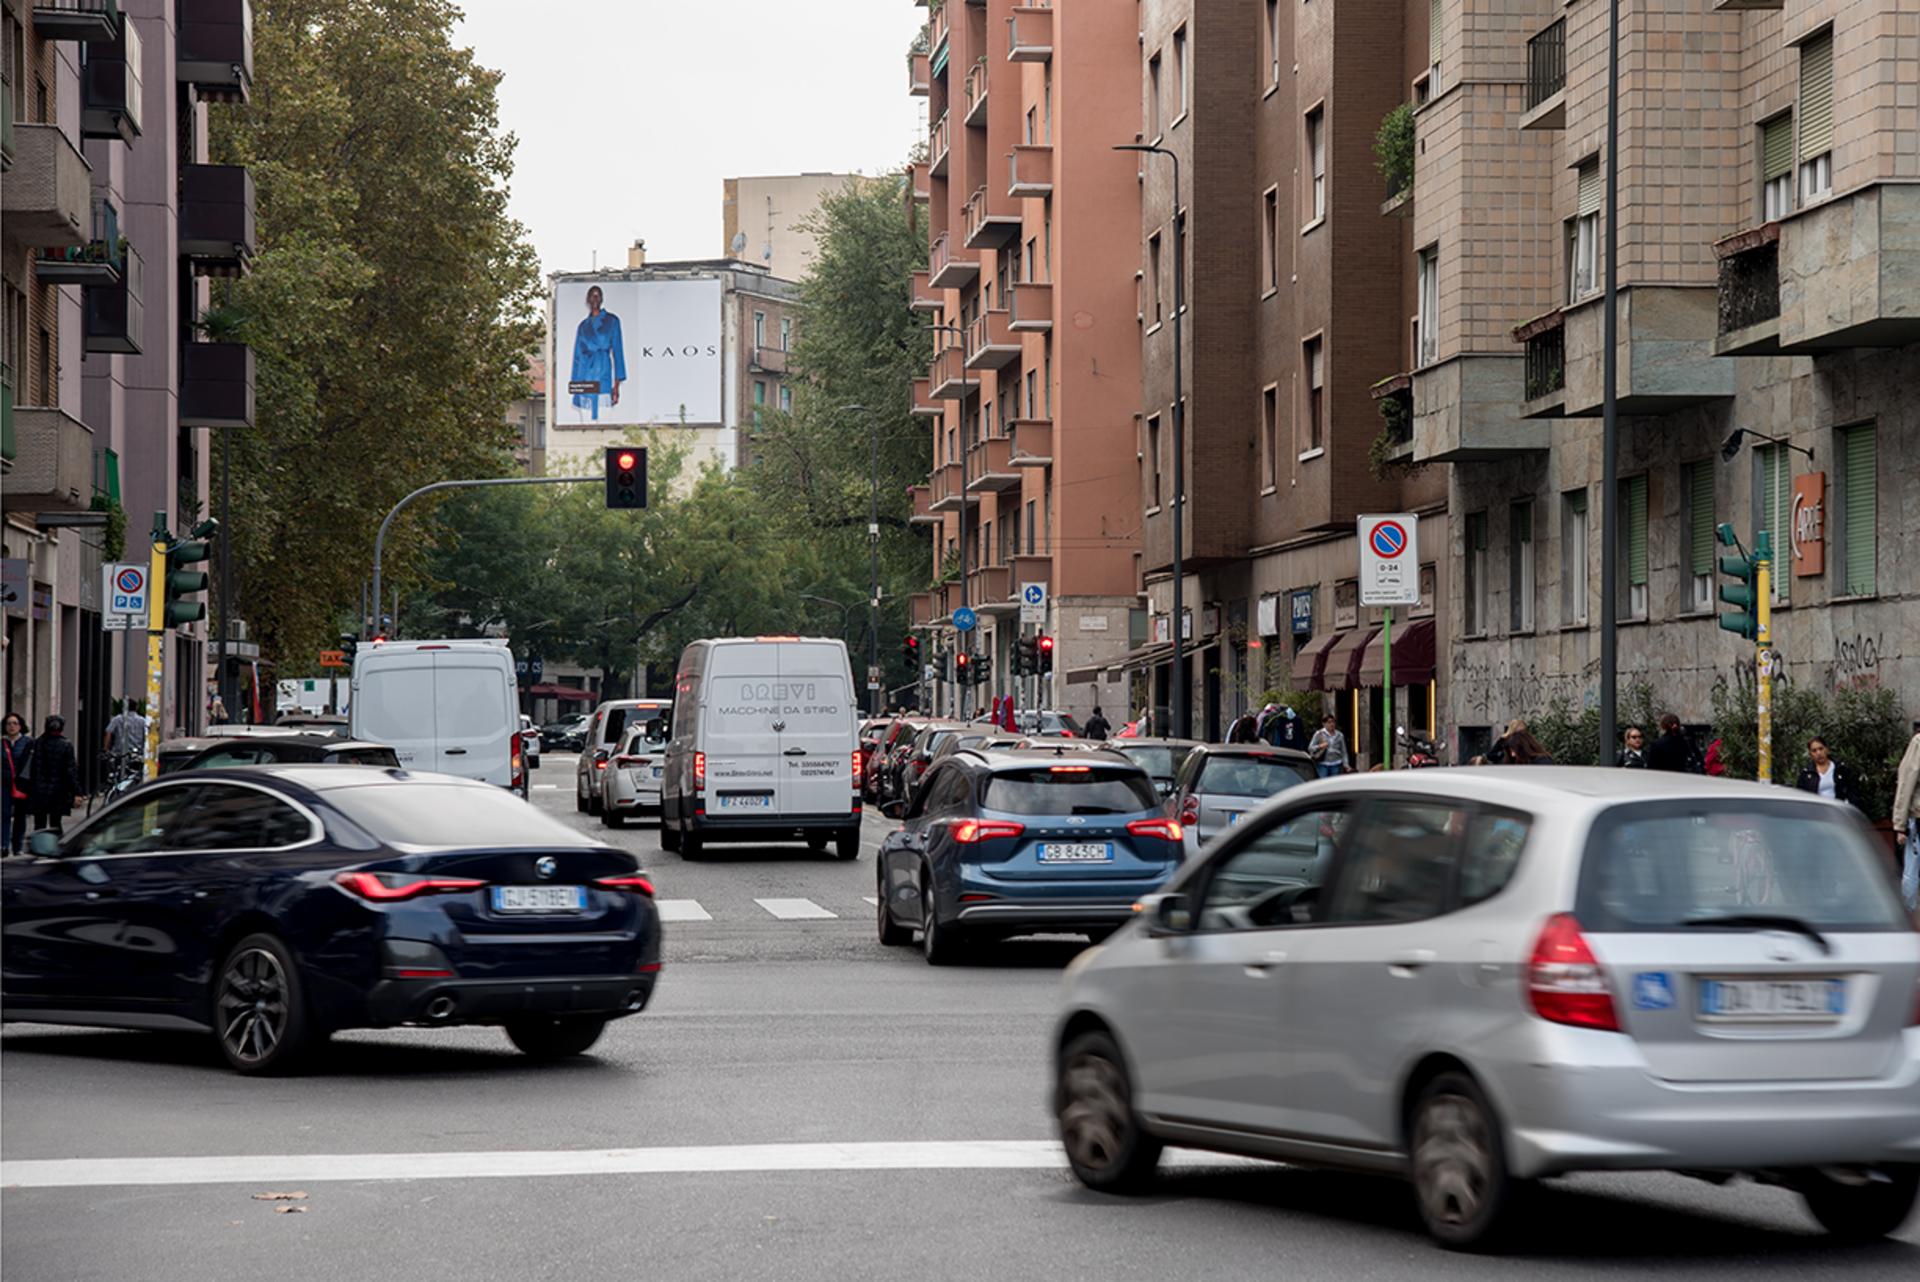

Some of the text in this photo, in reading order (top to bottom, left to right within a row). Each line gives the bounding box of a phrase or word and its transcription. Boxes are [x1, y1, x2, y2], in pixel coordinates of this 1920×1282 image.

[643, 346, 716, 357] KAOS
[321, 653, 340, 661] TAX
[719, 706, 837, 715] MACCHINE DA STIRO
